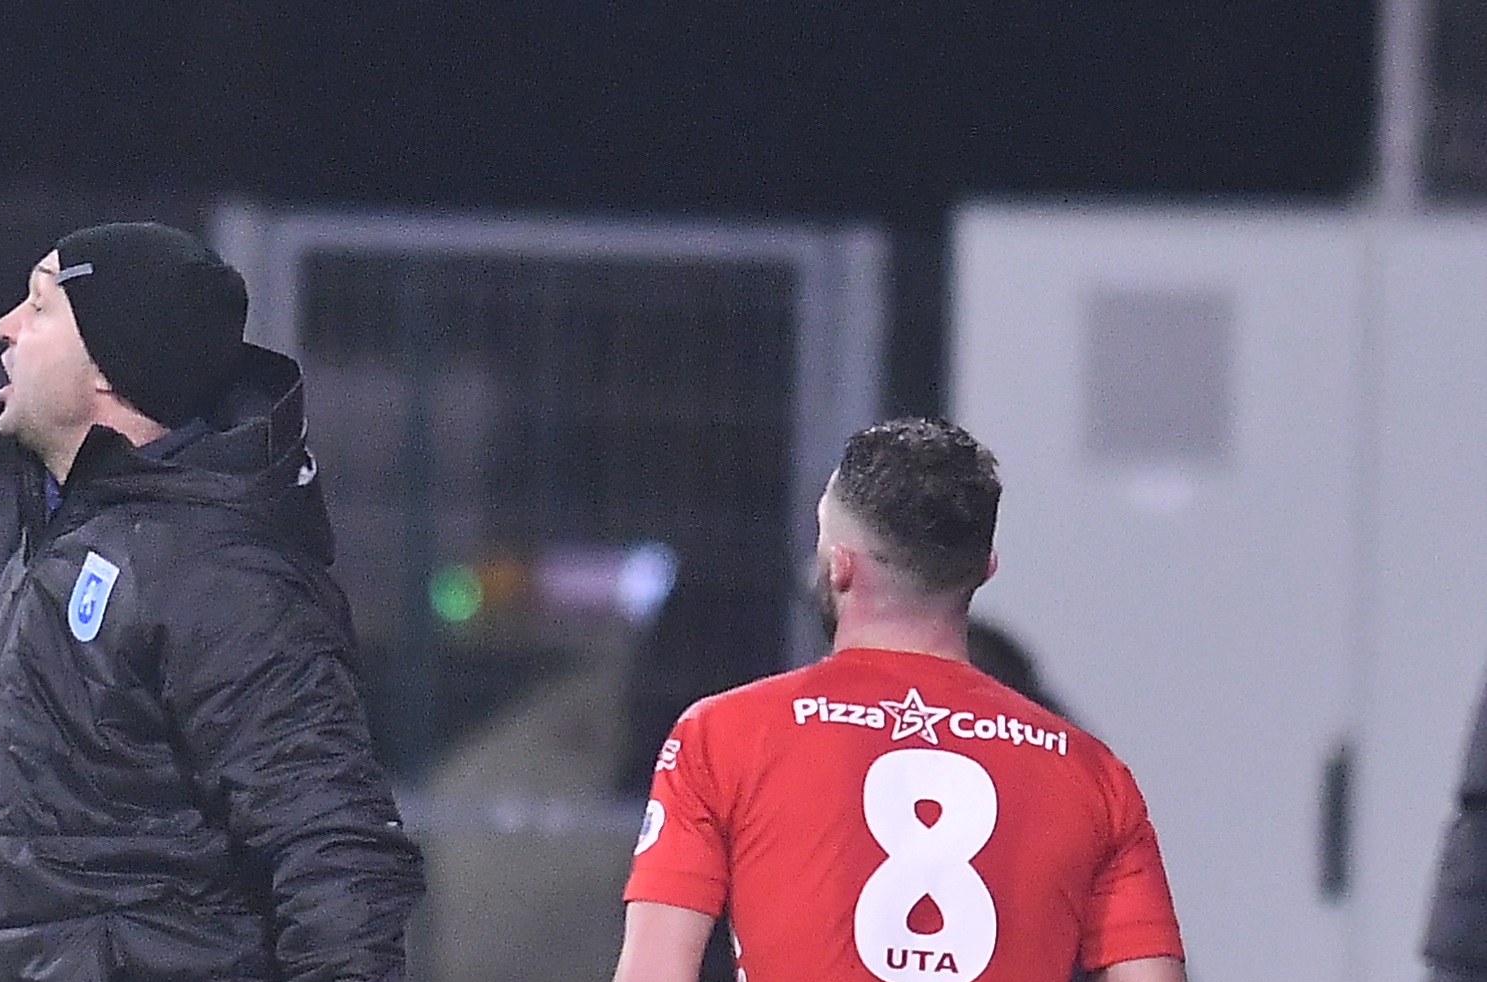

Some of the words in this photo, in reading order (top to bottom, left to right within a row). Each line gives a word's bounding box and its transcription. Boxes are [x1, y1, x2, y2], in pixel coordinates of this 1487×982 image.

[793, 697, 885, 728] Pizza
[902, 711, 924, 732] 5
[886, 947, 959, 974] UTA
